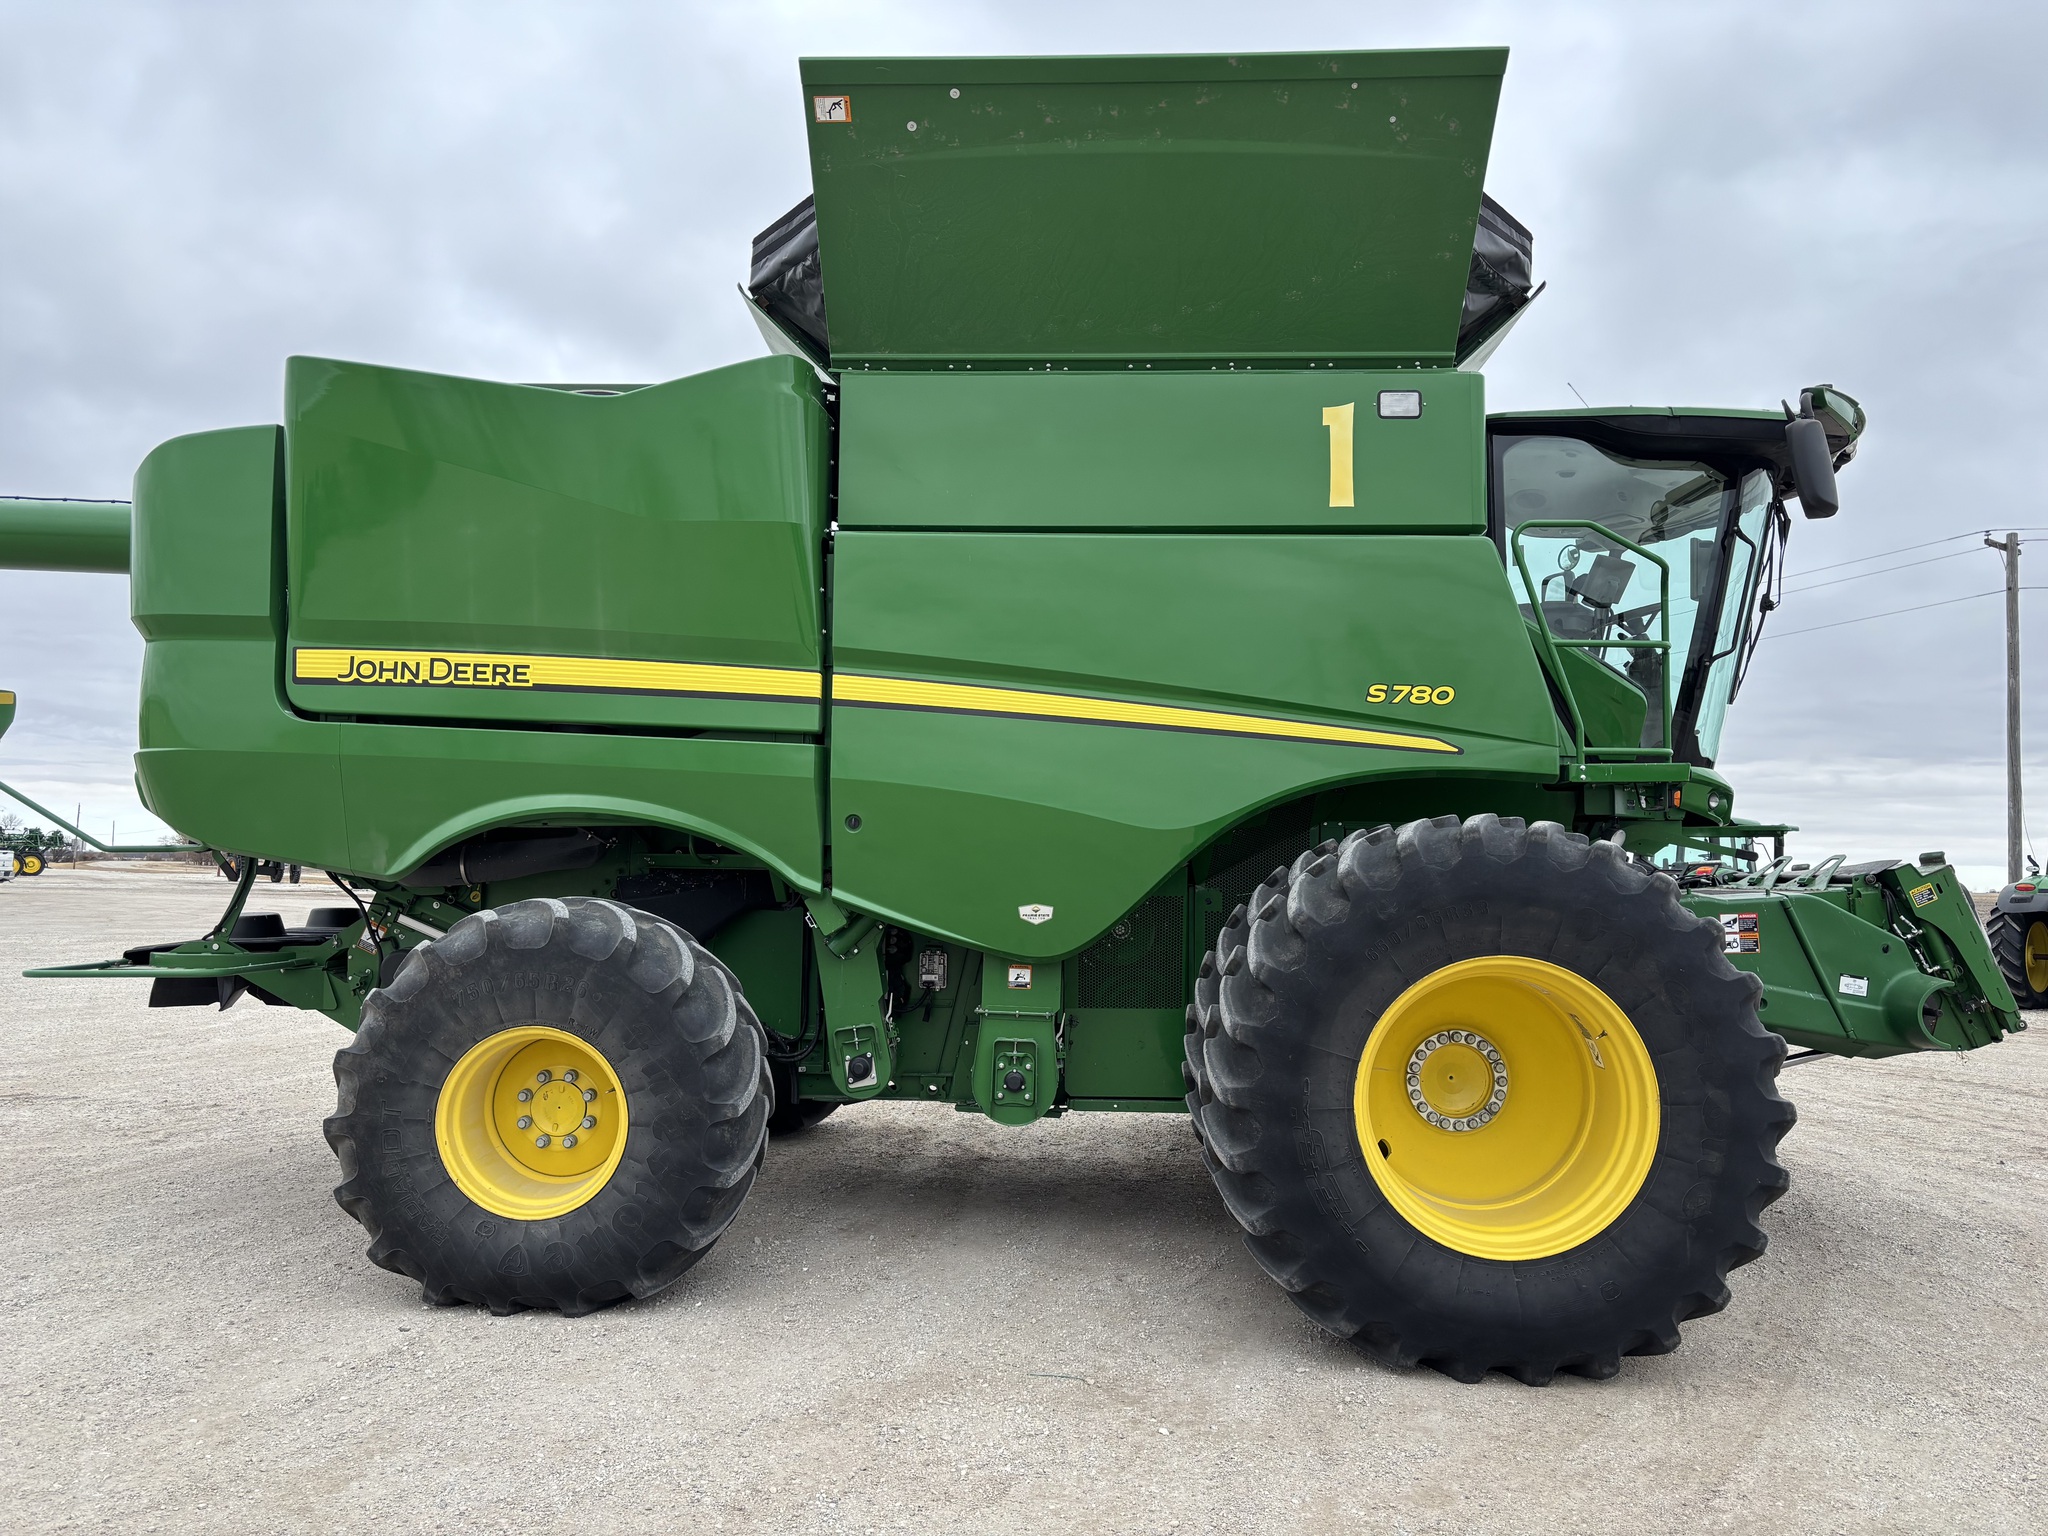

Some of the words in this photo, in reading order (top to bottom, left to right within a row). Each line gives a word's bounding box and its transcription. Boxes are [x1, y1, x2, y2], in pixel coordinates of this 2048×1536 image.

[1322, 402, 1355, 508] 1
[338, 656, 420, 680] JOHN
[429, 657, 531, 684] DEERE
[1365, 683, 1456, 706] S780
